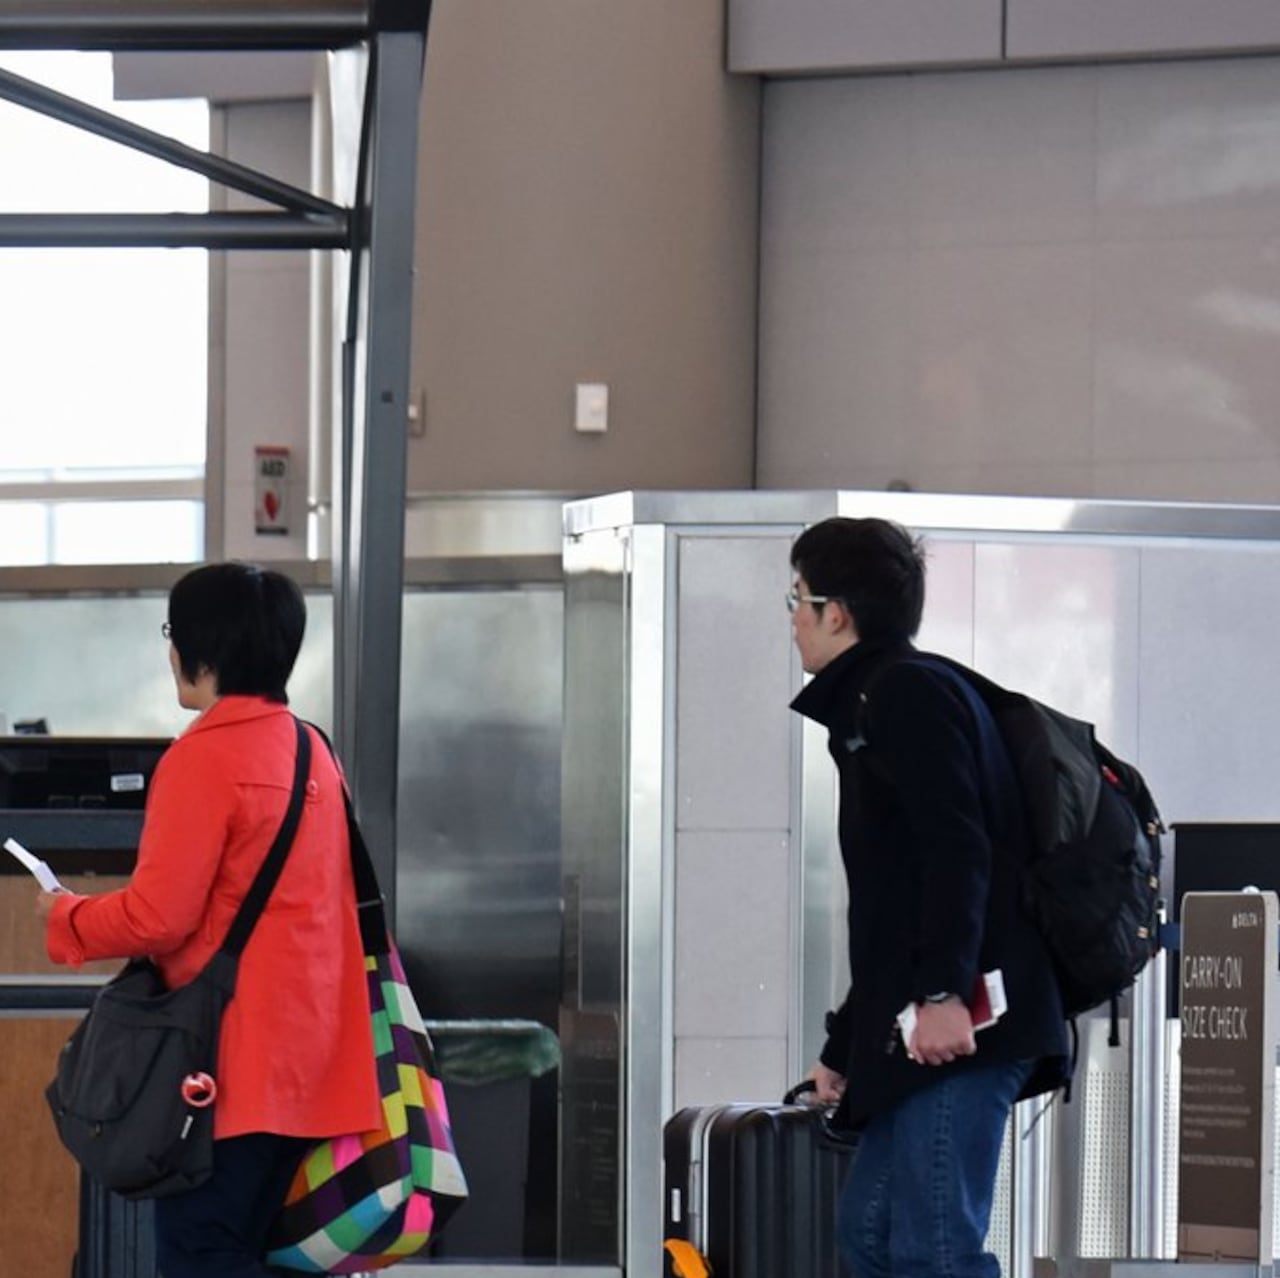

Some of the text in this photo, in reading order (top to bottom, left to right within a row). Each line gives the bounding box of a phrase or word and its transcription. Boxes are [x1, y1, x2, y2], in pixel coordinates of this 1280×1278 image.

[1183, 955, 1243, 989] CARRY-ON
[1182, 1005, 1249, 1041] SIZE CHECK
